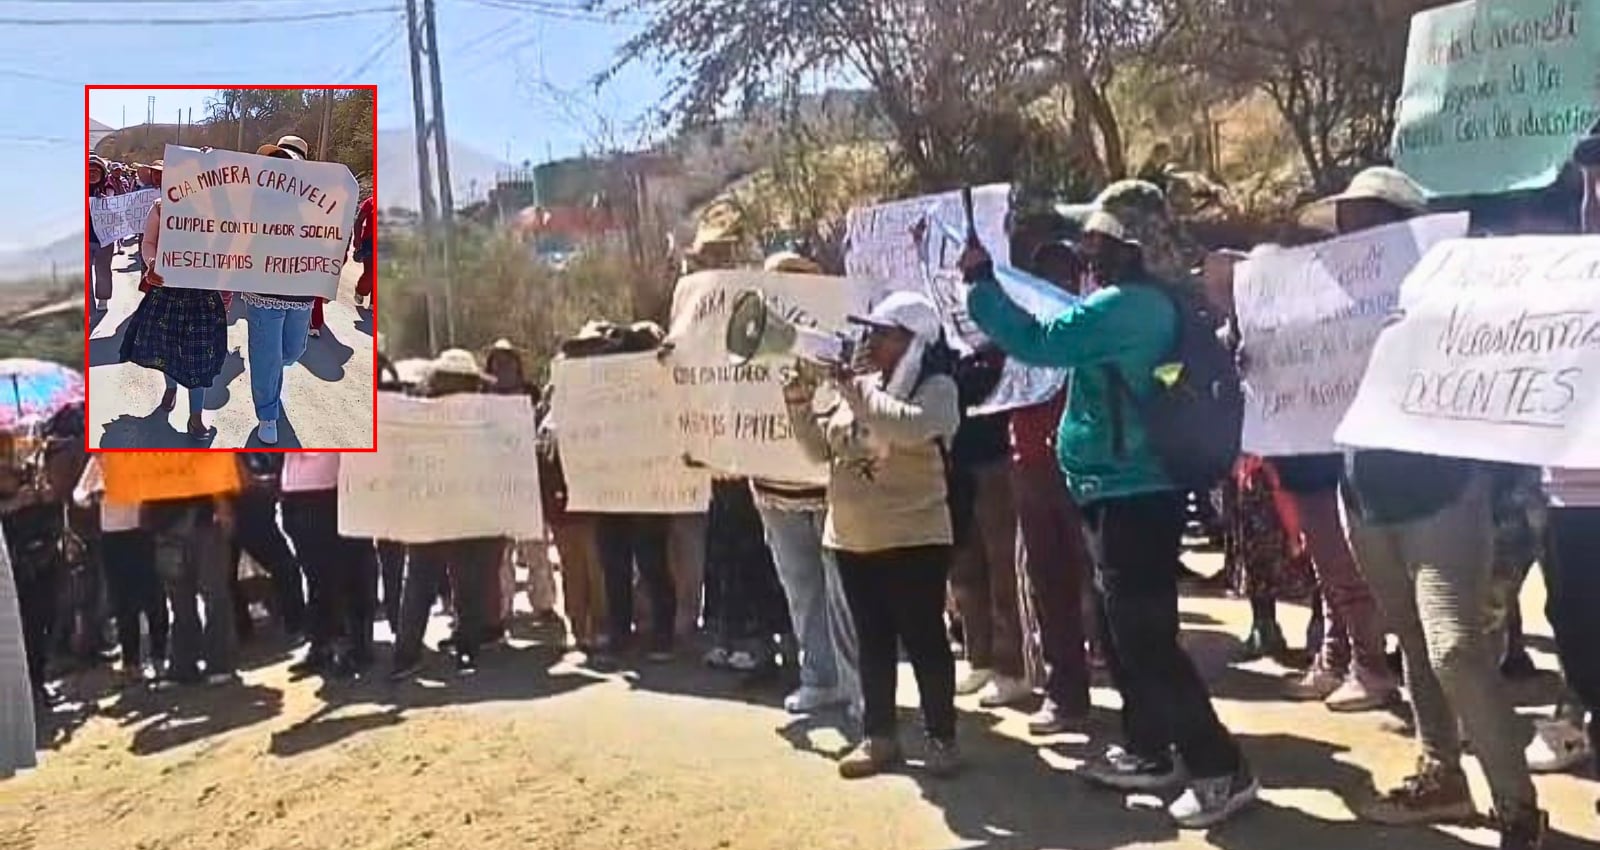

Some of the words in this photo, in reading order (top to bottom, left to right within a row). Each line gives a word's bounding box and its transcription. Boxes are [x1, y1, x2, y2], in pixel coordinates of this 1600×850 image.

[197, 165, 251, 190] MINERA
[256, 169, 337, 215] CARAVELI
[166, 215, 215, 233] CUMPLE
[220, 221, 241, 234] CON
[242, 222, 258, 234] TU
[262, 223, 295, 237] LABOR
[299, 225, 343, 241] SOCIAL
